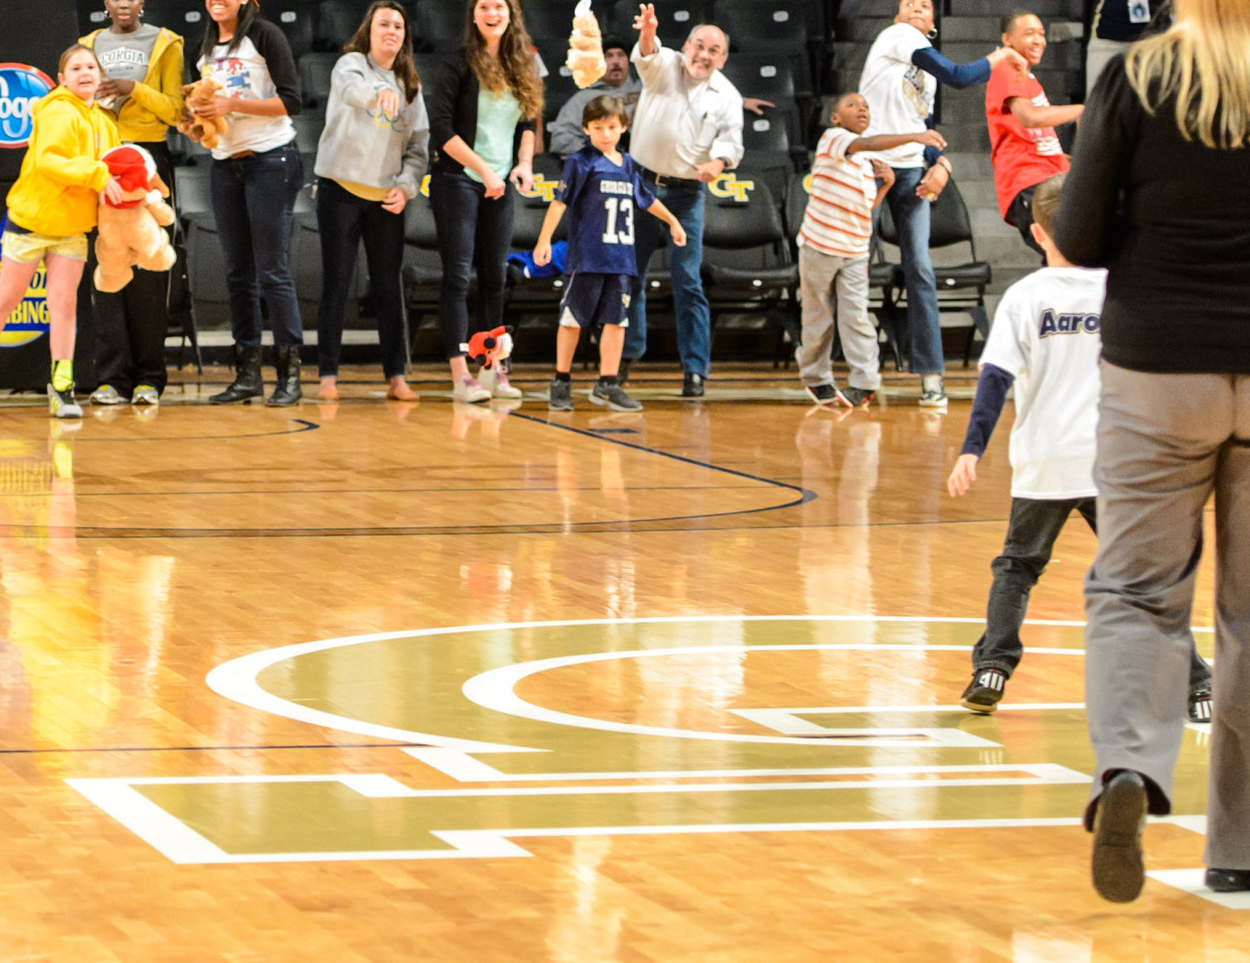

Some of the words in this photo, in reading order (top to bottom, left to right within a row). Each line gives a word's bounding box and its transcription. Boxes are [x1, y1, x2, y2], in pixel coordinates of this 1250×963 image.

[98, 47, 145, 66] EORGIA
[708, 173, 754, 202] GT
[602, 197, 635, 246] 13
